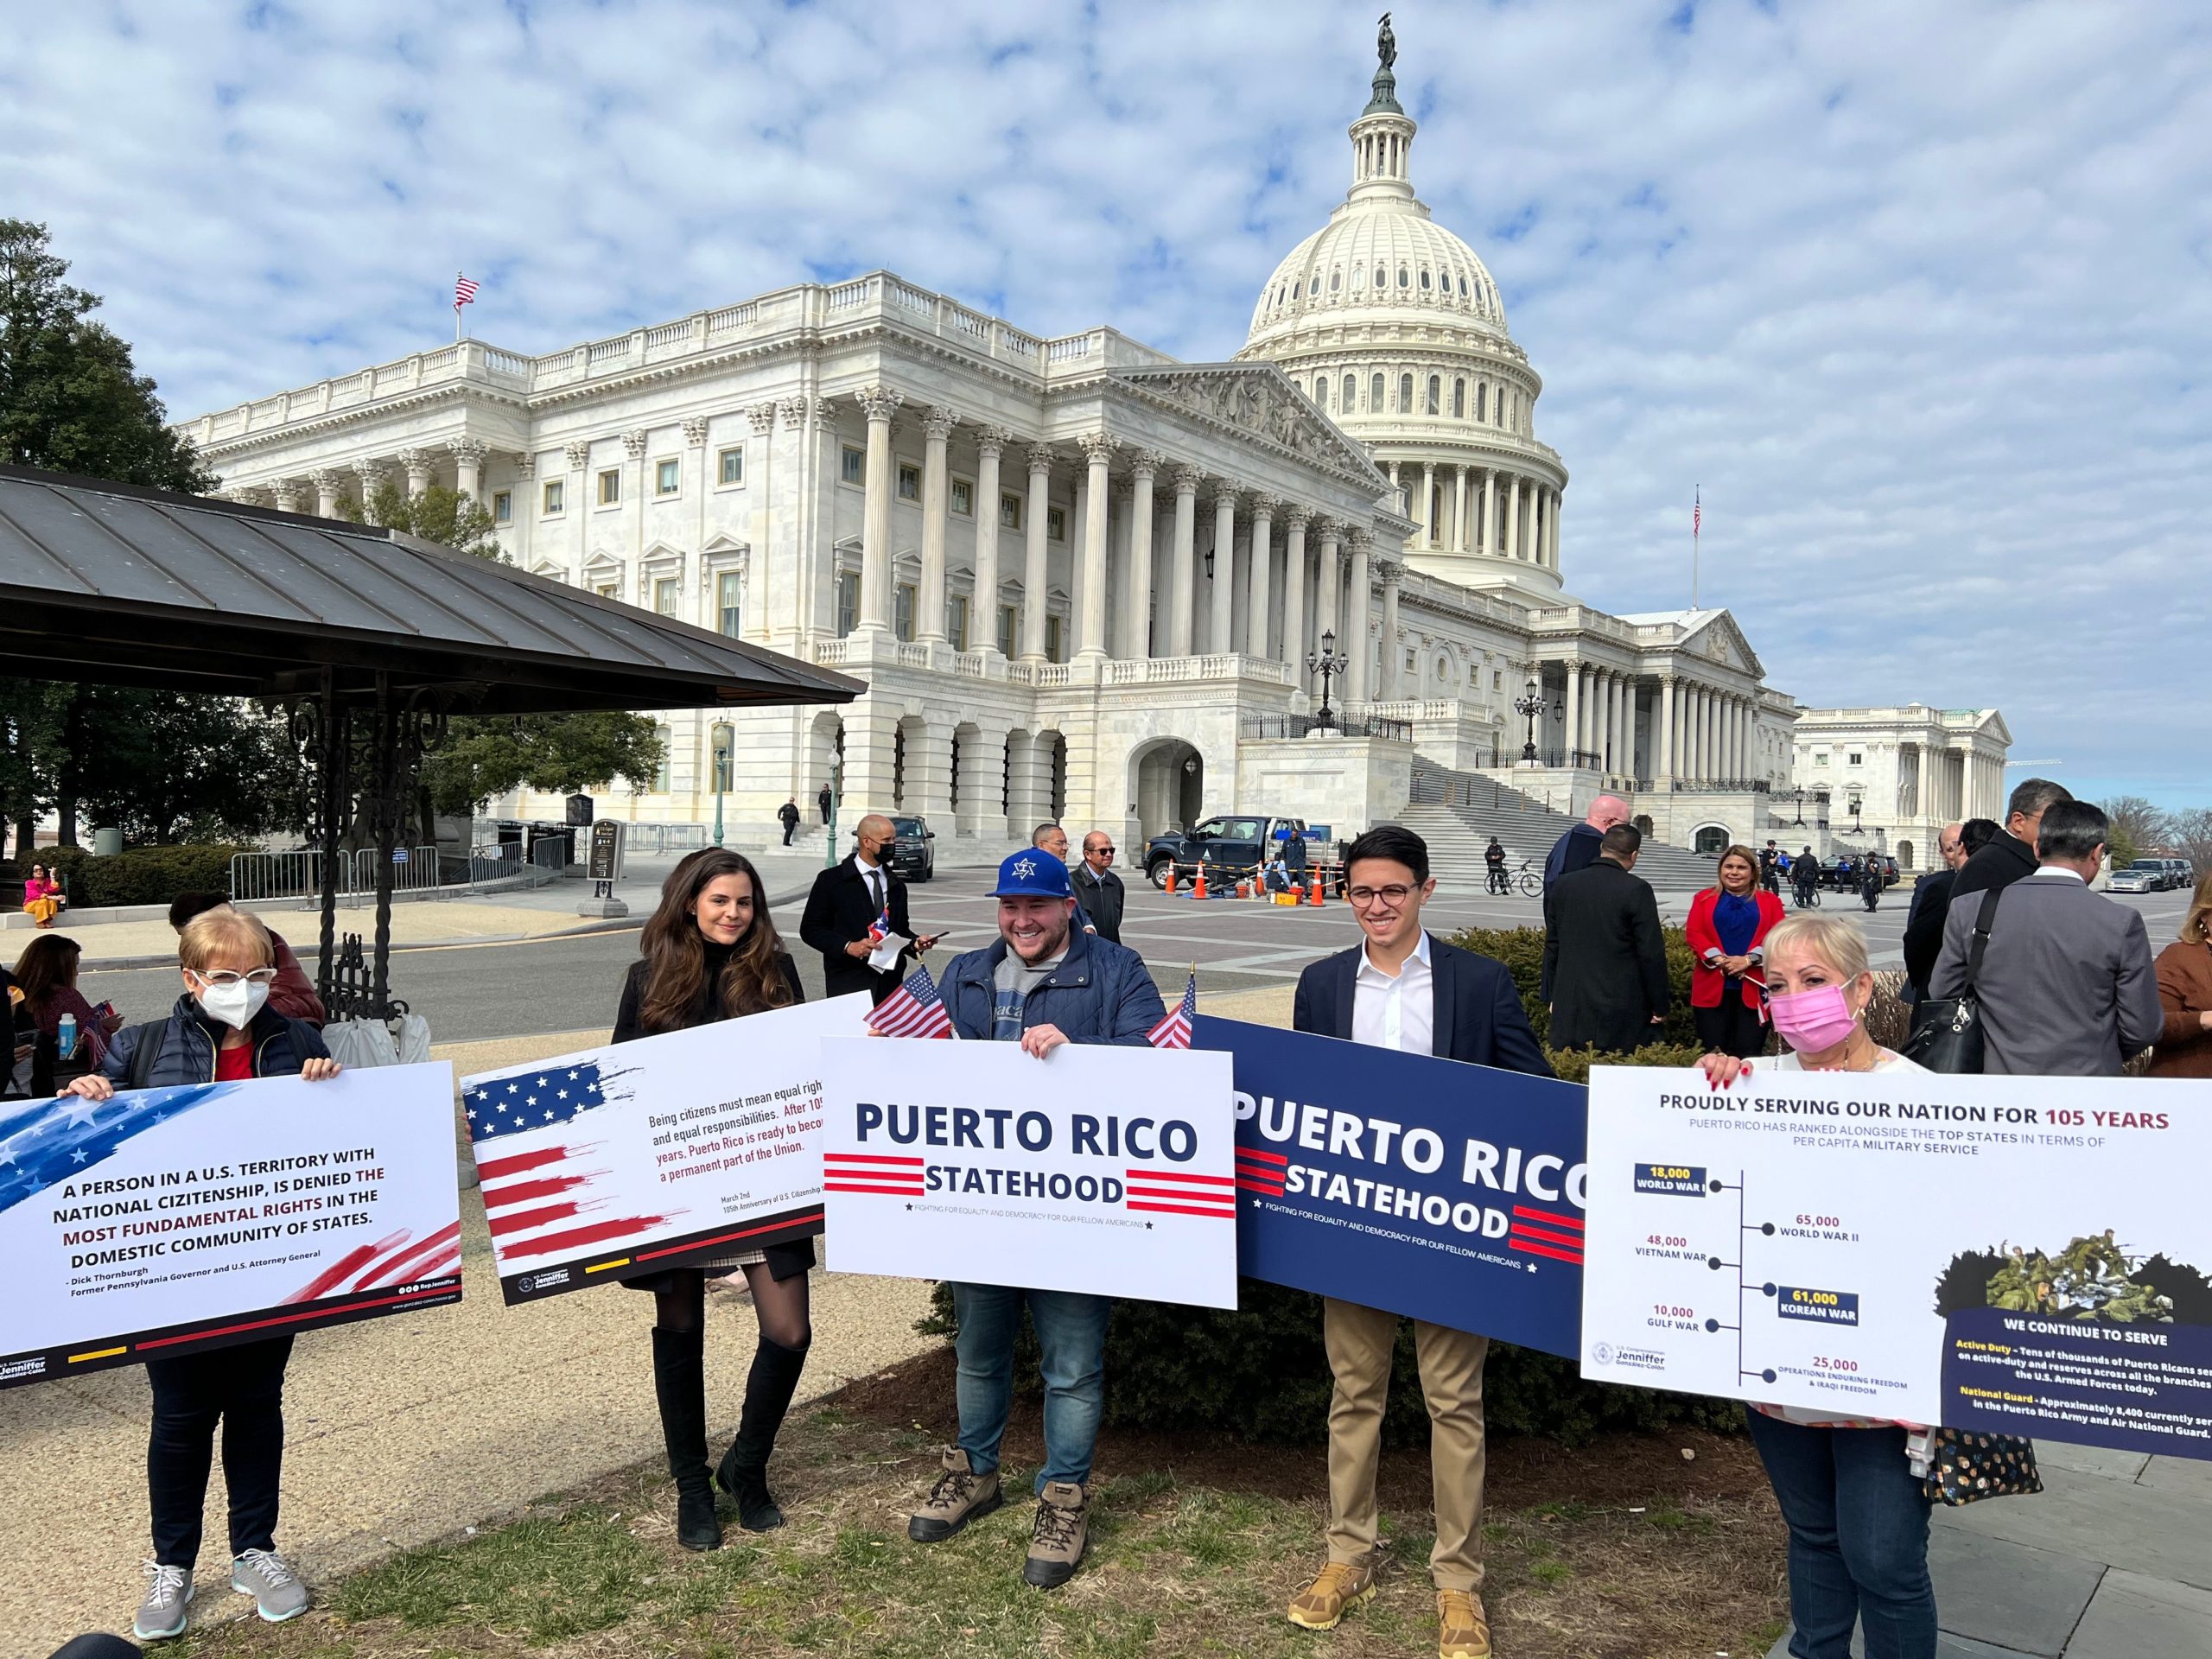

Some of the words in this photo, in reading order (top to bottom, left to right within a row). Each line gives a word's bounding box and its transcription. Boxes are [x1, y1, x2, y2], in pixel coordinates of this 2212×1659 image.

[648, 1113, 677, 1128] Being
[679, 1105, 716, 1121] citizens
[718, 1096, 743, 1112] must
[745, 1093, 772, 1107] mean
[774, 1084, 801, 1101] equal
[803, 1079, 822, 1095] righ
[1660, 1094, 1748, 1111] PROUDLY
[1754, 1097, 1839, 1116] SERVING
[1847, 1101, 1891, 1117] OUR
[1898, 1103, 1986, 1122] NATION
[1993, 1107, 2038, 1123] FOR
[2045, 1109, 2084, 1125] 105
[2092, 1110, 2169, 1129] YEARS
[652, 1130, 671, 1146] and
[673, 1124, 701, 1142] equal
[702, 1109, 779, 1135] responsibilities.
[784, 1103, 806, 1116] After
[856, 1103, 1052, 1152] PUERTO
[1071, 1113, 1198, 1162] RICO
[1233, 1090, 1444, 1173] PUERTO
[1689, 1118, 1732, 1128] PUERTO
[1734, 1120, 1760, 1130] RICO
[1763, 1122, 1786, 1132] HAS
[1789, 1122, 1836, 1134] RANKED
[1839, 1125, 1908, 1138] ALONGSIDE
[1910, 1128, 1935, 1139] THE
[1937, 1129, 1964, 1140] TOP
[1967, 1131, 2018, 1143] STATES
[2021, 1134, 2034, 1144] IN
[2037, 1134, 2084, 1147] TERMS
[2087, 1136, 2105, 1147] OF
[656, 1150, 686, 1167] years.
[688, 1141, 720, 1156] Puerto
[721, 1135, 744, 1149] Rico
[745, 1132, 755, 1144] is
[757, 1125, 784, 1141] ready
[786, 1123, 796, 1135] to
[798, 1118, 823, 1132] beco
[1793, 1136, 1815, 1146] PER
[1817, 1137, 1859, 1148] CAPITA
[1863, 1140, 1921, 1152] MILITARY
[1923, 1142, 1979, 1154] SERVICE
[62, 1185, 76, 1198] A
[81, 1174, 154, 1196] PERSON
[160, 1172, 180, 1186] IN
[185, 1170, 198, 1183] A
[202, 1166, 234, 1180] U.S.
[238, 1153, 328, 1176] TERRITORY
[332, 1147, 374, 1164] WITH
[659, 1173, 666, 1182] a
[668, 1158, 721, 1183] permanent
[722, 1154, 743, 1171] part
[745, 1149, 754, 1162] of
[755, 1147, 772, 1160] the
[773, 1141, 804, 1156] Union.
[1649, 1166, 1690, 1179] 18,000
[53, 1198, 153, 1224] NATIONAL
[157, 1184, 269, 1209] CIZITENSHIP,
[274, 1179, 289, 1193] IS
[293, 1172, 351, 1191] DENIED
[355, 1167, 384, 1182] THE
[925, 1165, 1123, 1203] STATEHOOD
[1637, 1179, 1674, 1190] WORLD
[1675, 1181, 1700, 1192] WAR
[721, 1193, 739, 1204] March
[739, 1191, 750, 1199] 2nd
[1286, 1165, 1509, 1239] STATEHOOD
[63, 1226, 117, 1246] MOST
[123, 1206, 258, 1237] FUNDAMENTAL
[263, 1197, 322, 1217] RIGHTS
[327, 1194, 344, 1208] IN
[348, 1189, 378, 1205] THE
[914, 1204, 944, 1212] FIGHTING
[958, 1206, 988, 1215] EQUALITY
[1005, 1210, 1046, 1220] DEMOCRACY
[1061, 1214, 1076, 1223] OUR
[1077, 1216, 1104, 1224] FELLOW
[1105, 1218, 1143, 1228] AMERICANS
[1796, 1214, 1839, 1227] 65,000
[71, 1242, 165, 1268] DOMESTIC
[170, 1224, 283, 1253] COMMUNITY
[287, 1221, 308, 1235] OF
[312, 1211, 372, 1231] STATES.
[1265, 1202, 1297, 1216] FIGHTING
[1298, 1210, 1313, 1219] FOR
[1313, 1213, 1347, 1227] EQUALITY
[1348, 1222, 1363, 1231] AND
[1364, 1224, 1411, 1242] DEMOCRACY
[1411, 1236, 1427, 1246] FOR
[1427, 1240, 1445, 1250] OUR
[1445, 1244, 1477, 1258] FELLOW
[1477, 1252, 1521, 1269] AMERICANS
[1647, 1235, 1687, 1247] 48,000
[1780, 1227, 1820, 1238] WORLD
[1822, 1230, 1848, 1241] WAR
[1852, 1233, 1859, 1242] II
[1635, 1247, 1680, 1259] VIETNAM
[1682, 1251, 1707, 1262] WAR
[71, 1286, 105, 1297] Former
[107, 1274, 168, 1291] Pennsylvania
[169, 1268, 212, 1281] Governor
[213, 1264, 229, 1274] and
[249, 1256, 287, 1268] Attorney
[288, 1249, 321, 1261] General
[71, 1275, 92, 1285] Dick
[93, 1267, 148, 1281] Thornburgh
[1792, 1290, 1837, 1305] 61,000
[1654, 1304, 1693, 1318] 10,000
[1781, 1303, 1827, 1317] KOREAN
[1828, 1308, 1856, 1320] WAR
[1647, 1318, 1672, 1328] GULF
[1675, 1321, 1699, 1332] WAR
[2003, 1318, 2025, 1331] WE
[2027, 1320, 2100, 1338] CONTINUE
[2101, 1328, 2121, 1341] TO
[2124, 1331, 2167, 1346] SERVE
[0, 1362, 45, 1375] Jenniffer
[1616, 1351, 1664, 1364] Jenniffer
[1813, 1356, 1858, 1371] 25,000
[1955, 1339, 1986, 1351] Active
[1987, 1343, 2011, 1355] Duty
[2019, 1346, 2043, 1357] Tens
[2044, 1350, 2056, 1358] of
[2056, 1351, 2109, 1364] thousands
[2111, 1357, 2122, 1366] of
[2124, 1358, 2158, 1370] Puerto
[2160, 1363, 2195, 1374] Ricans
[1777, 1365, 1826, 1378] OPERATIONS
[1827, 1372, 1868, 1383] ENDURING
[1870, 1378, 1907, 1389] FREEDOM
[2015, 1370, 2032, 1379] the
[2034, 1372, 2052, 1382] U.S.
[2054, 1374, 2088, 1386] Armed
[2089, 1378, 2122, 1390] Forces
[2124, 1382, 2157, 1395] today.
[1960, 1386, 2001, 1399] National
[2003, 1392, 2032, 1403] Guard
[2040, 1396, 2114, 1415] Approximately
[2116, 1406, 2143, 1417] 8,400
[2145, 1411, 2193, 1426] currently
